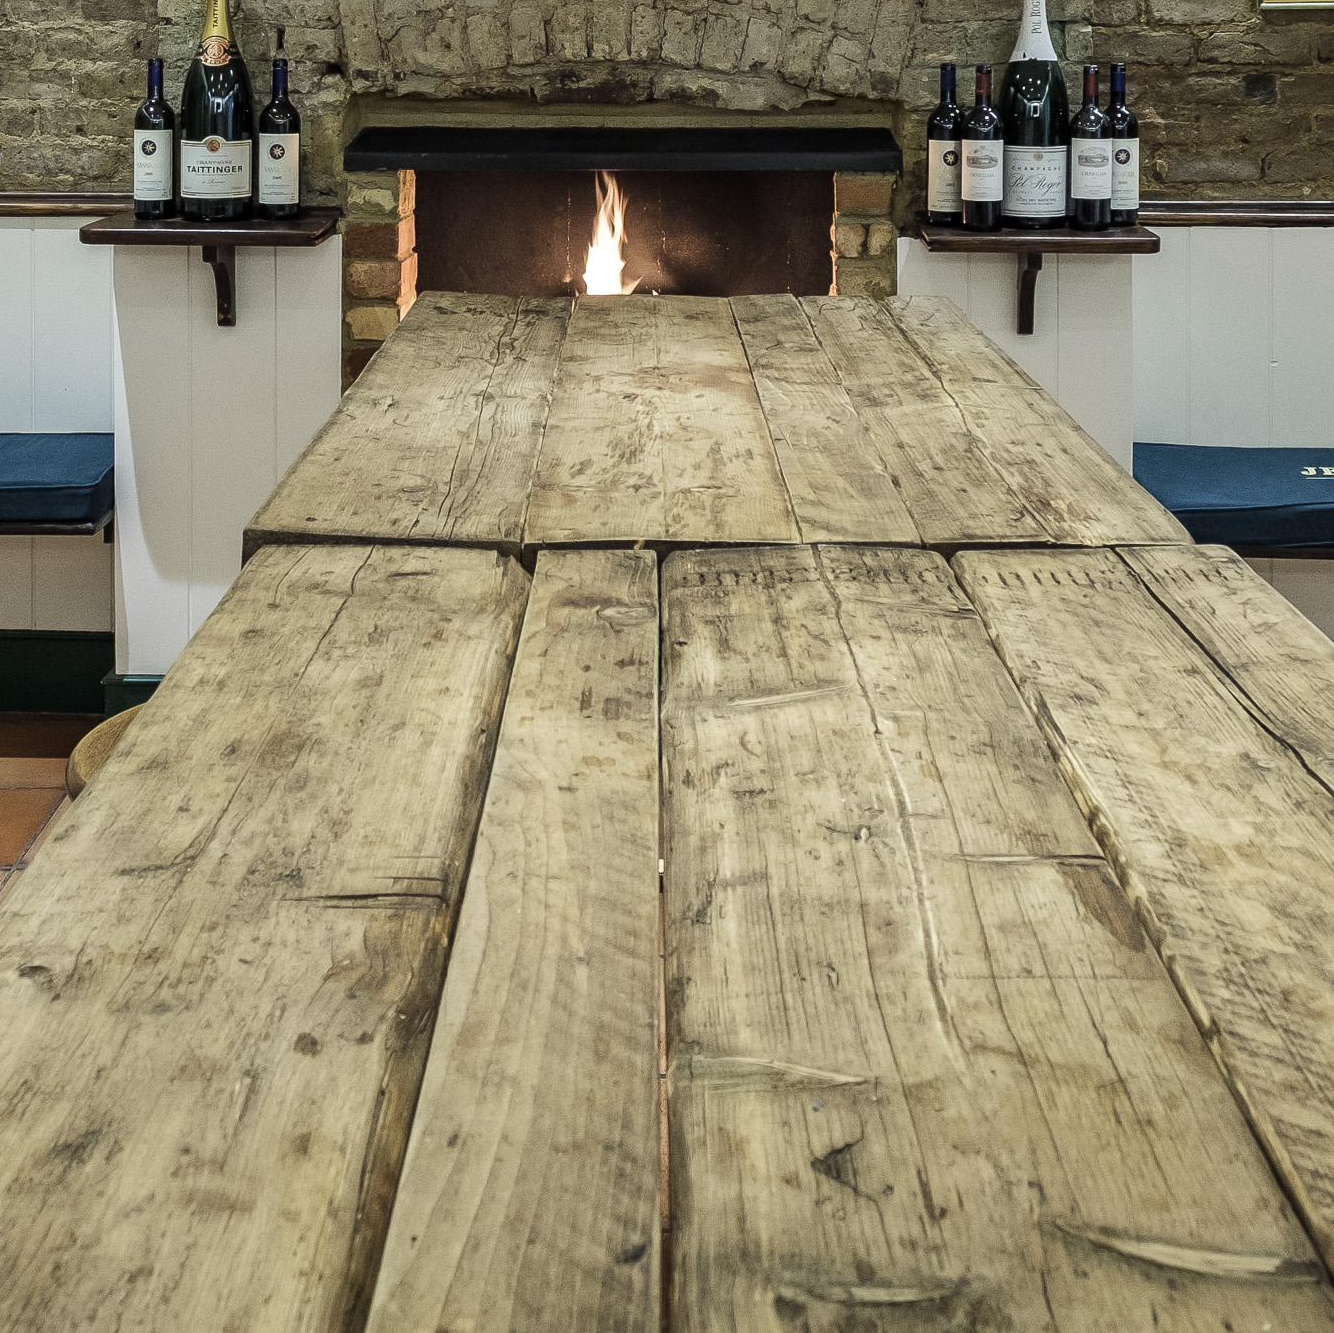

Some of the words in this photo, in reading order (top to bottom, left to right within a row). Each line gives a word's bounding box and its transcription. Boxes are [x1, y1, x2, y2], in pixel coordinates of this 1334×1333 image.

[1030, 20, 1042, 34] POL
[186, 165, 243, 173] TAITTINGER
[1008, 172, 1032, 188] Pol
[1029, 173, 1063, 197] Roger
